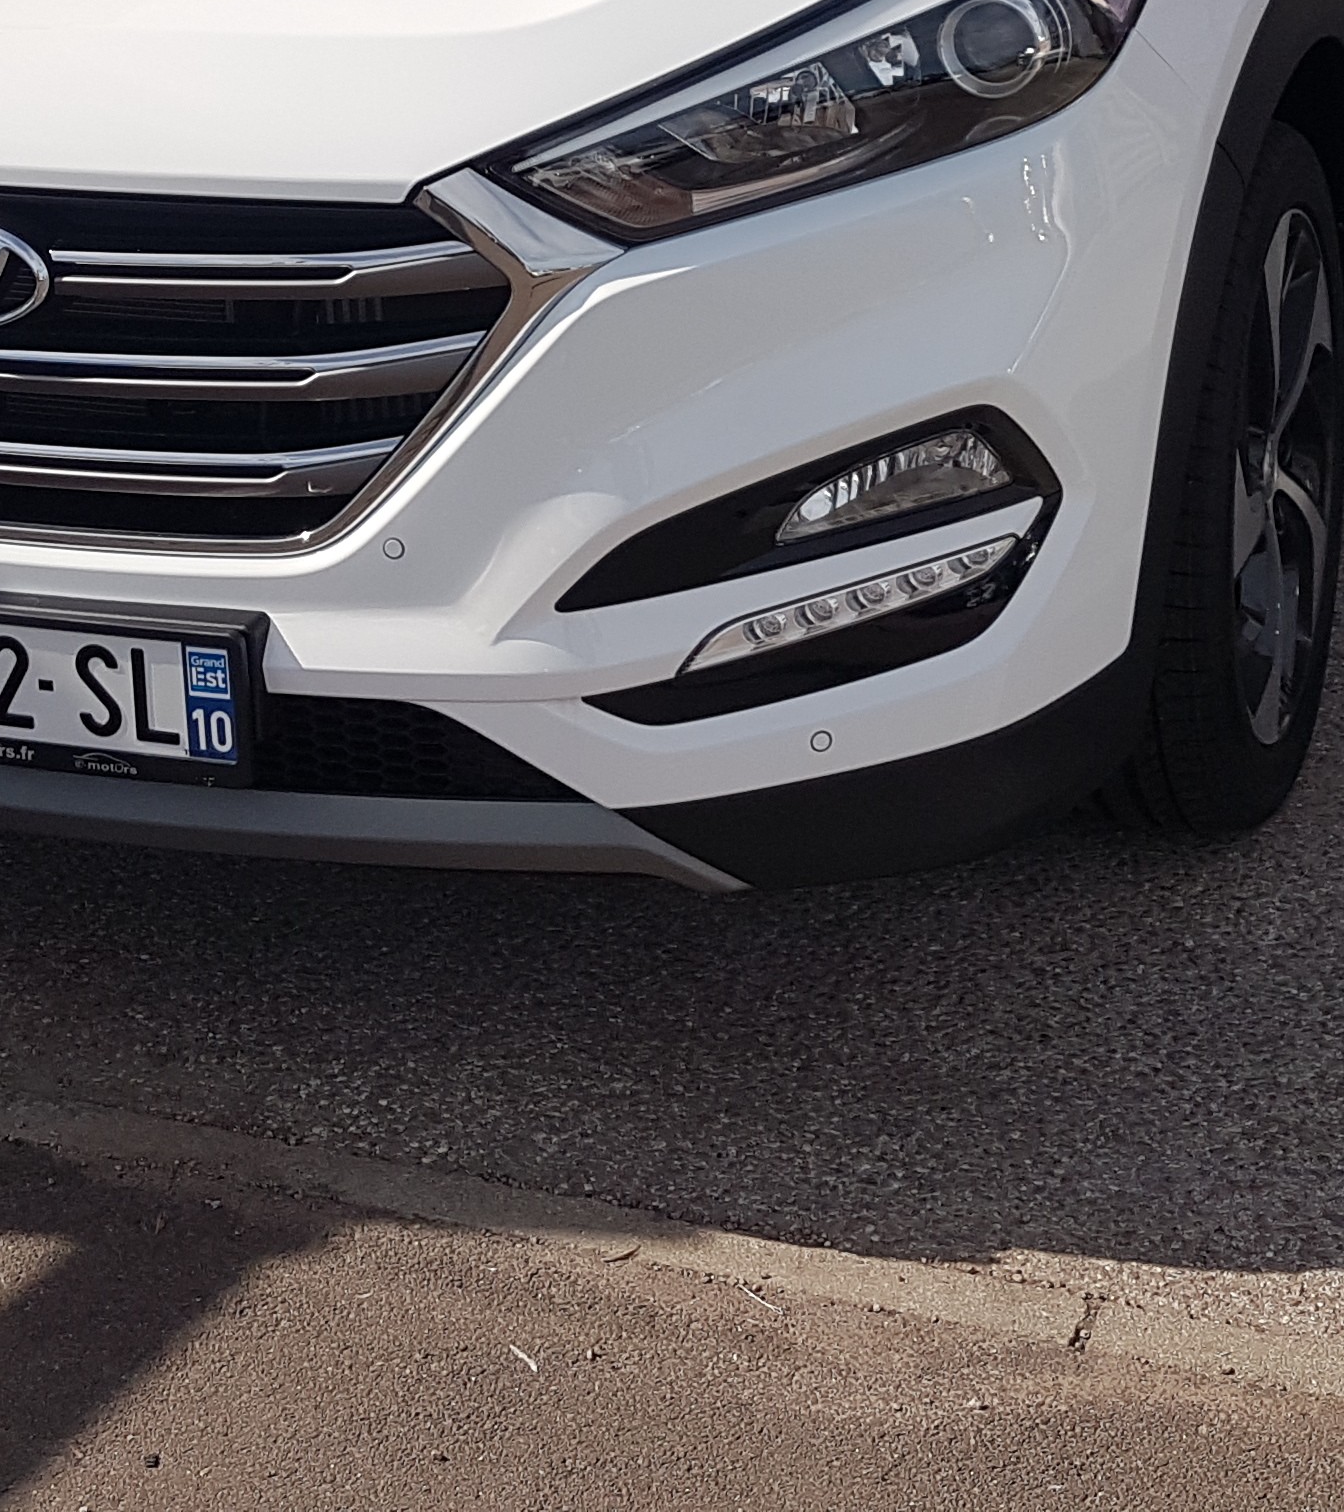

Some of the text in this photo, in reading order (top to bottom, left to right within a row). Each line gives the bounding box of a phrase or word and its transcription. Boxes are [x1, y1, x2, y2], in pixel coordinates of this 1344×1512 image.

[190, 655, 225, 668] Grand
[191, 666, 226, 689] Est
[191, 708, 233, 753] 10
